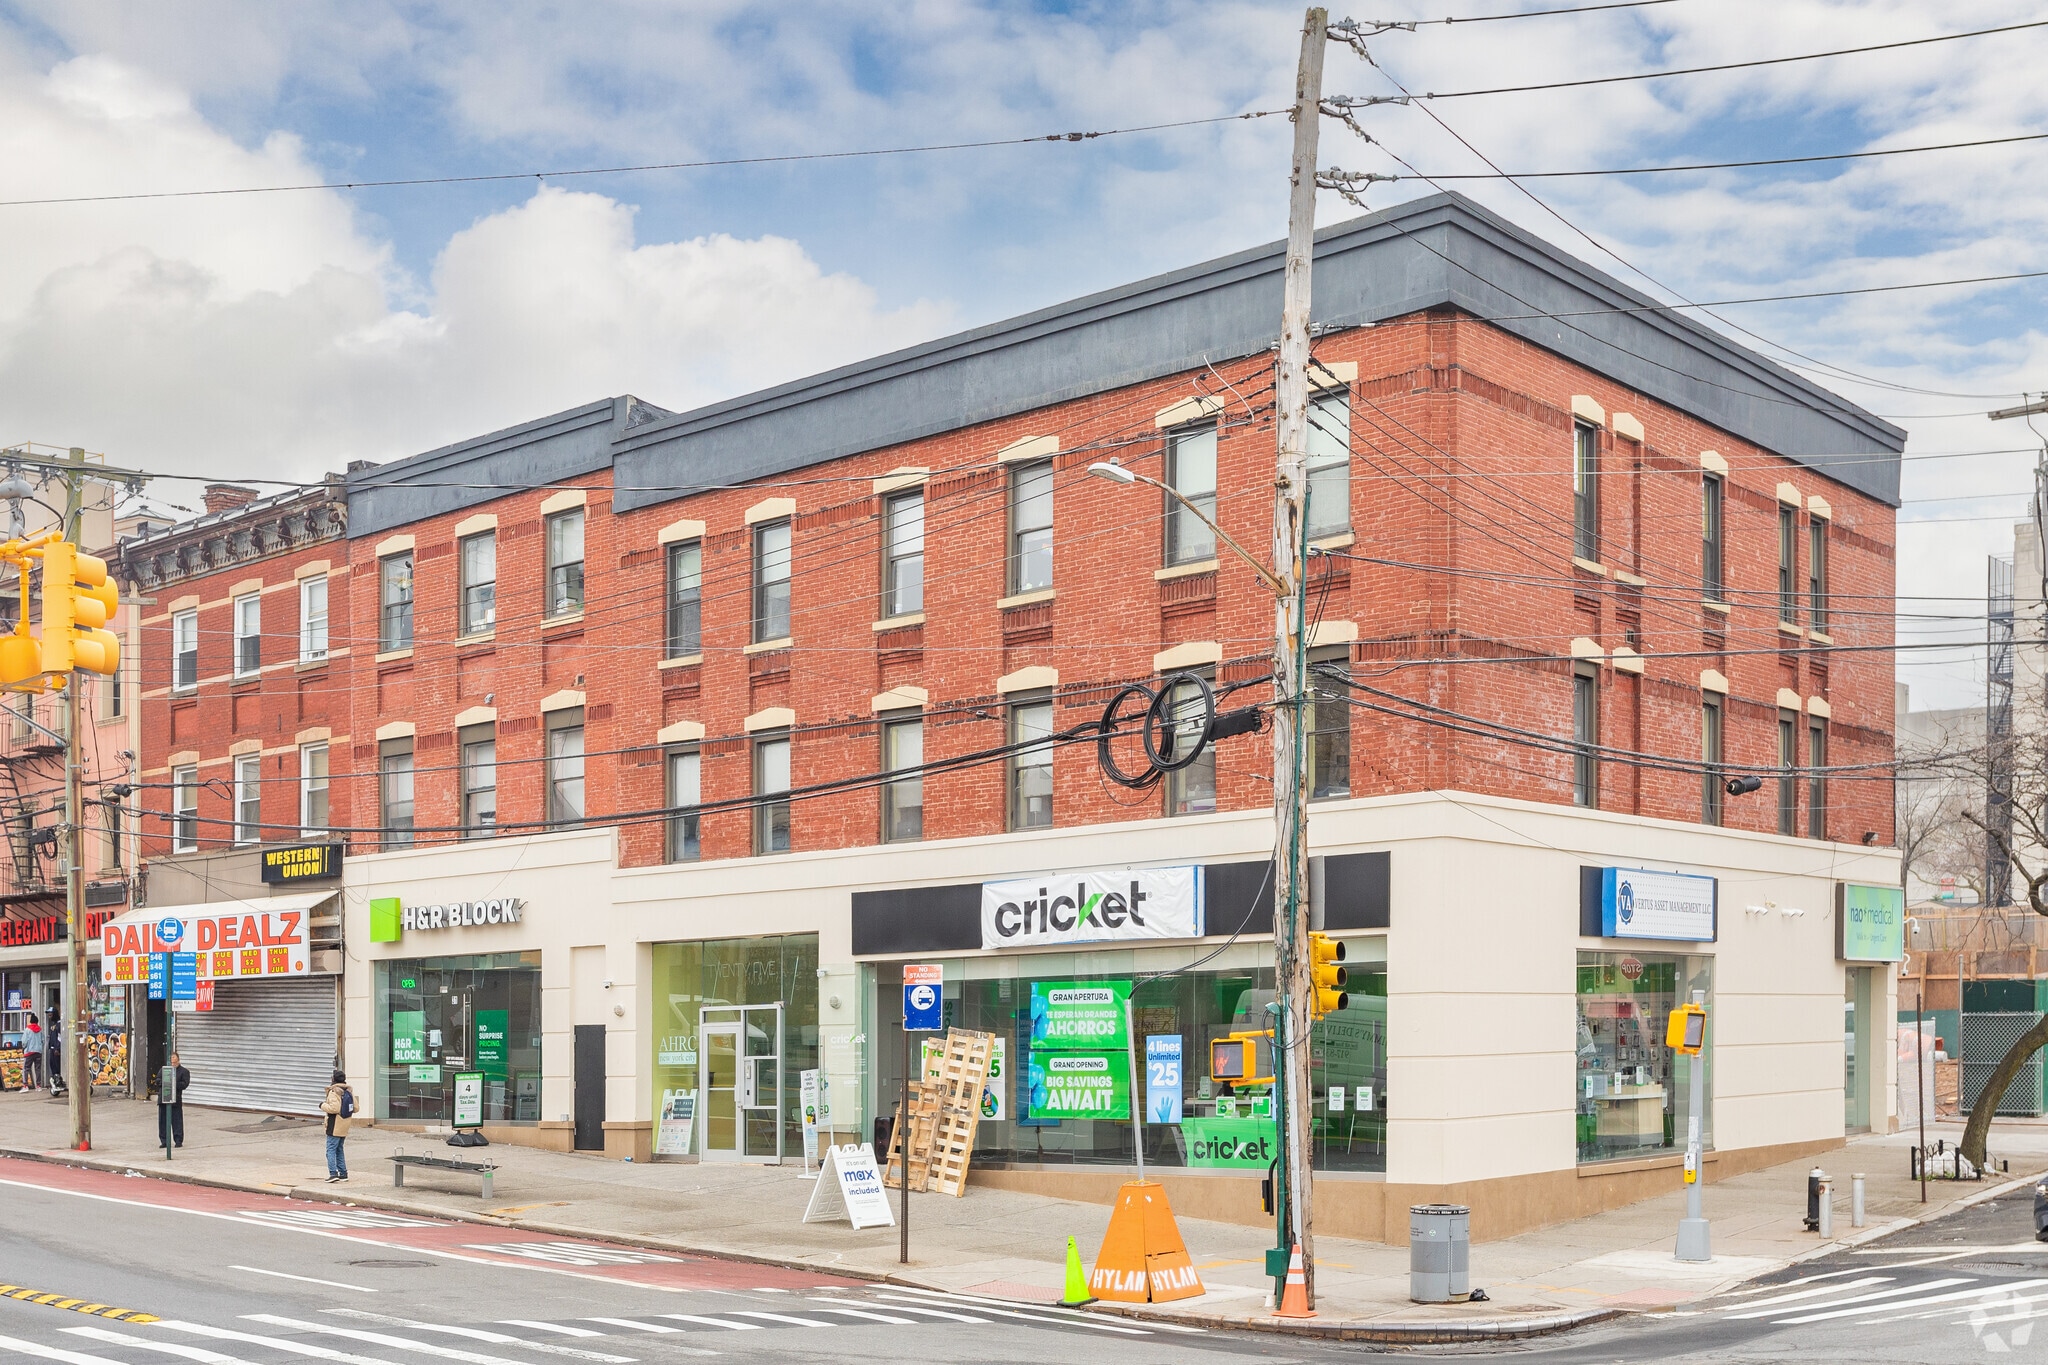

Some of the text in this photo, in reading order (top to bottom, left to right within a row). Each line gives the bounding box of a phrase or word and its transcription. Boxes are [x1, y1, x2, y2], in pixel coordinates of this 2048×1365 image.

[266, 847, 320, 866] WESTERN
[282, 861, 320, 878] UNION
[994, 880, 1147, 938] cricket
[1620, 895, 1632, 911] VA
[1634, 898, 1712, 915] VERTUS ASSET MANAGEMENT LLC
[403, 898, 518, 931] H&R BLOCK
[1850, 904, 1894, 925] nao medical
[0, 916, 57, 947] ELEGANT
[197, 911, 302, 951] DEALZ
[401, 979, 416, 989] OPEN
[1052, 993, 1109, 1002] GRAN APERTURA
[1054, 1011, 1083, 1019] ESPERAN
[1084, 1010, 1117, 1018] GRANDES
[479, 1032, 504, 1040] SURPRISE
[1046, 1020, 1116, 1036] AHORROS
[394, 1038, 412, 1049] H&R
[658, 1035, 697, 1052] AHRC
[830, 1033, 866, 1045] cricket
[1147, 1040, 1180, 1052] 4 lines
[394, 1049, 422, 1061] BLOCK
[659, 1053, 696, 1064] new york city
[1148, 1053, 1181, 1061] Unlimited
[1046, 1076, 1113, 1087] BIG SAVINGS
[1148, 1062, 1179, 1087] $25
[465, 1084, 471, 1092] 4
[1046, 1089, 1114, 1110] AWAIT
[1193, 1135, 1269, 1161] cricket
[843, 1169, 875, 1182] max
[848, 1186, 880, 1195] included
[1092, 1265, 1198, 1292] HYLAN HYLAN
